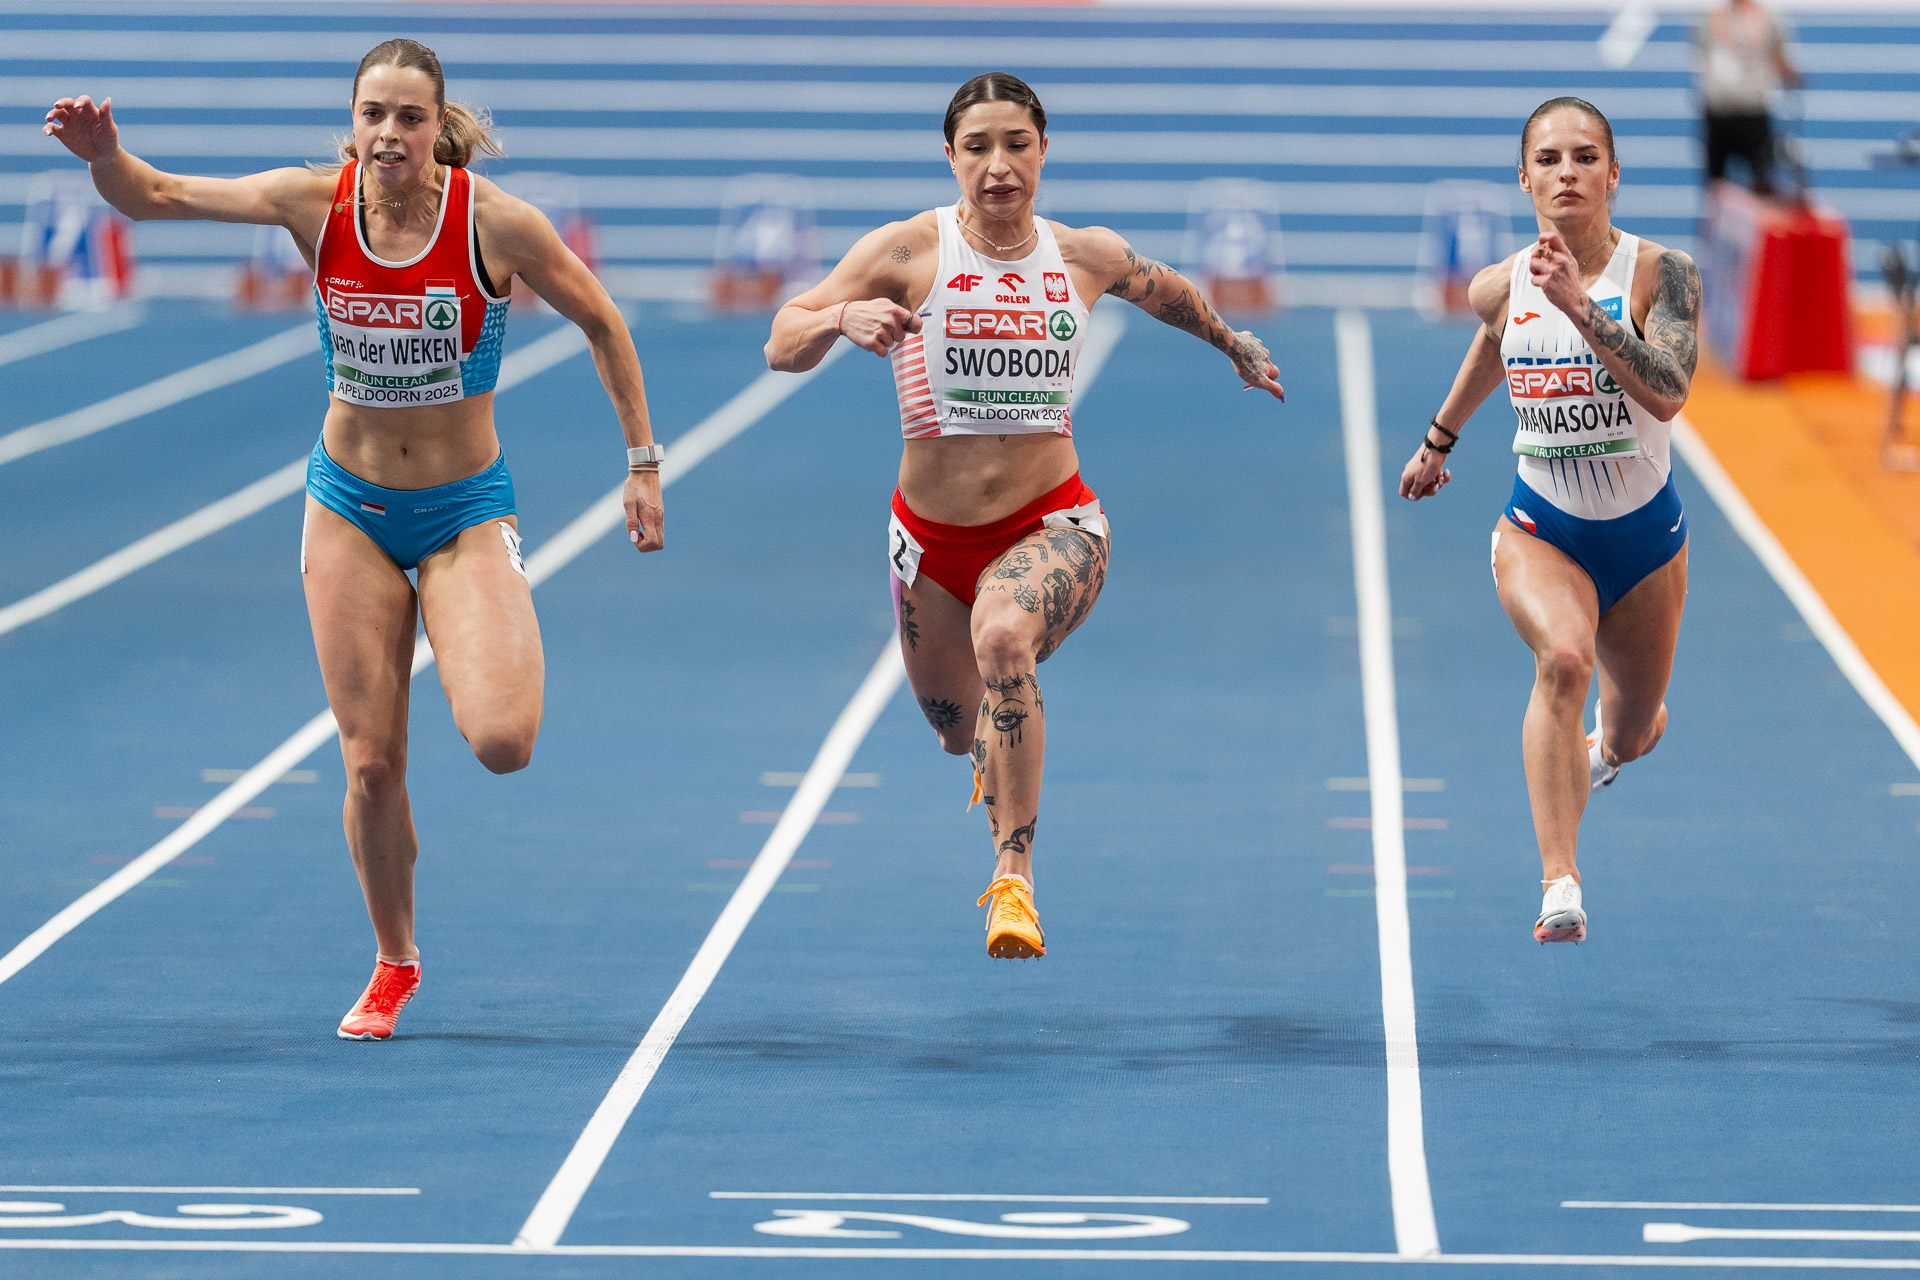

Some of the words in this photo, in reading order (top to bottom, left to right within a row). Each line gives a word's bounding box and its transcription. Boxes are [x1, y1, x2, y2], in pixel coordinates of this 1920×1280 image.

[330, 277, 356, 287] CRAFT
[947, 273, 983, 291] 4F
[995, 294, 1030, 304] ORLEN
[331, 296, 419, 325] SPAR
[949, 313, 1044, 336] SPAR
[332, 332, 355, 358] van
[360, 335, 385, 364] der
[390, 337, 457, 365] WEKEN
[945, 346, 1070, 378] SWOBODA
[360, 372, 383, 387] RUN
[1510, 371, 1591, 395] SPAR
[338, 381, 424, 402] APELDOORN
[425, 383, 459, 401] 2025
[971, 391, 975, 401] I
[978, 391, 1007, 402] RUN
[949, 406, 1040, 421] APELDOORN
[1515, 394, 1632, 434] MANASOVÁ
[1534, 446, 1539, 457] I
[1538, 447, 1562, 459] RUN
[893, 529, 907, 572] 2
[753, 1208, 1191, 1240] 2
